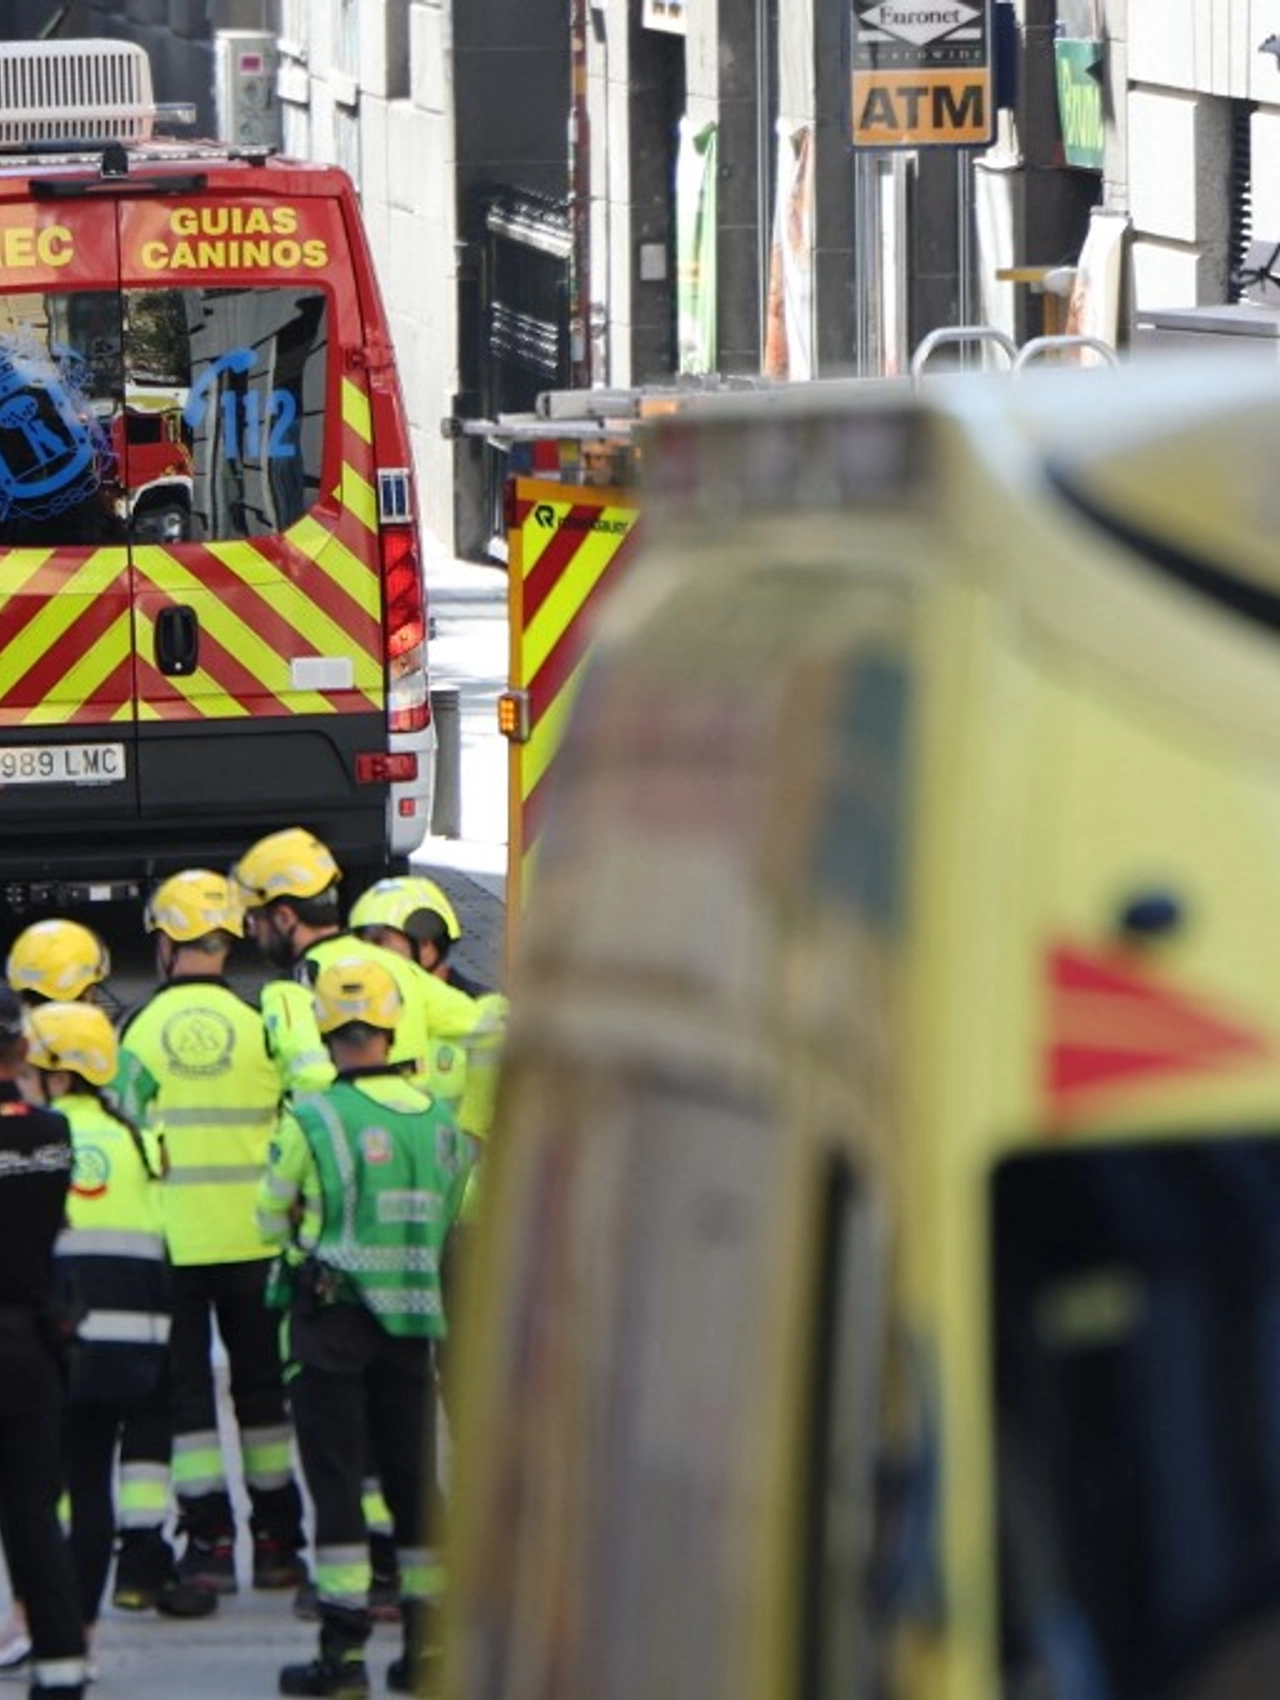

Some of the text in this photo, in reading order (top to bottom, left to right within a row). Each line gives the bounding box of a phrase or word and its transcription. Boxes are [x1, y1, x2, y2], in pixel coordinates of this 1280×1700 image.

[880, 6, 960, 26] Euronet
[859, 85, 984, 129] ATM
[170, 207, 298, 236] GUIAS
[142, 240, 329, 270] CANINOS
[221, 388, 297, 459] 112
[65, 748, 117, 776] LMC
